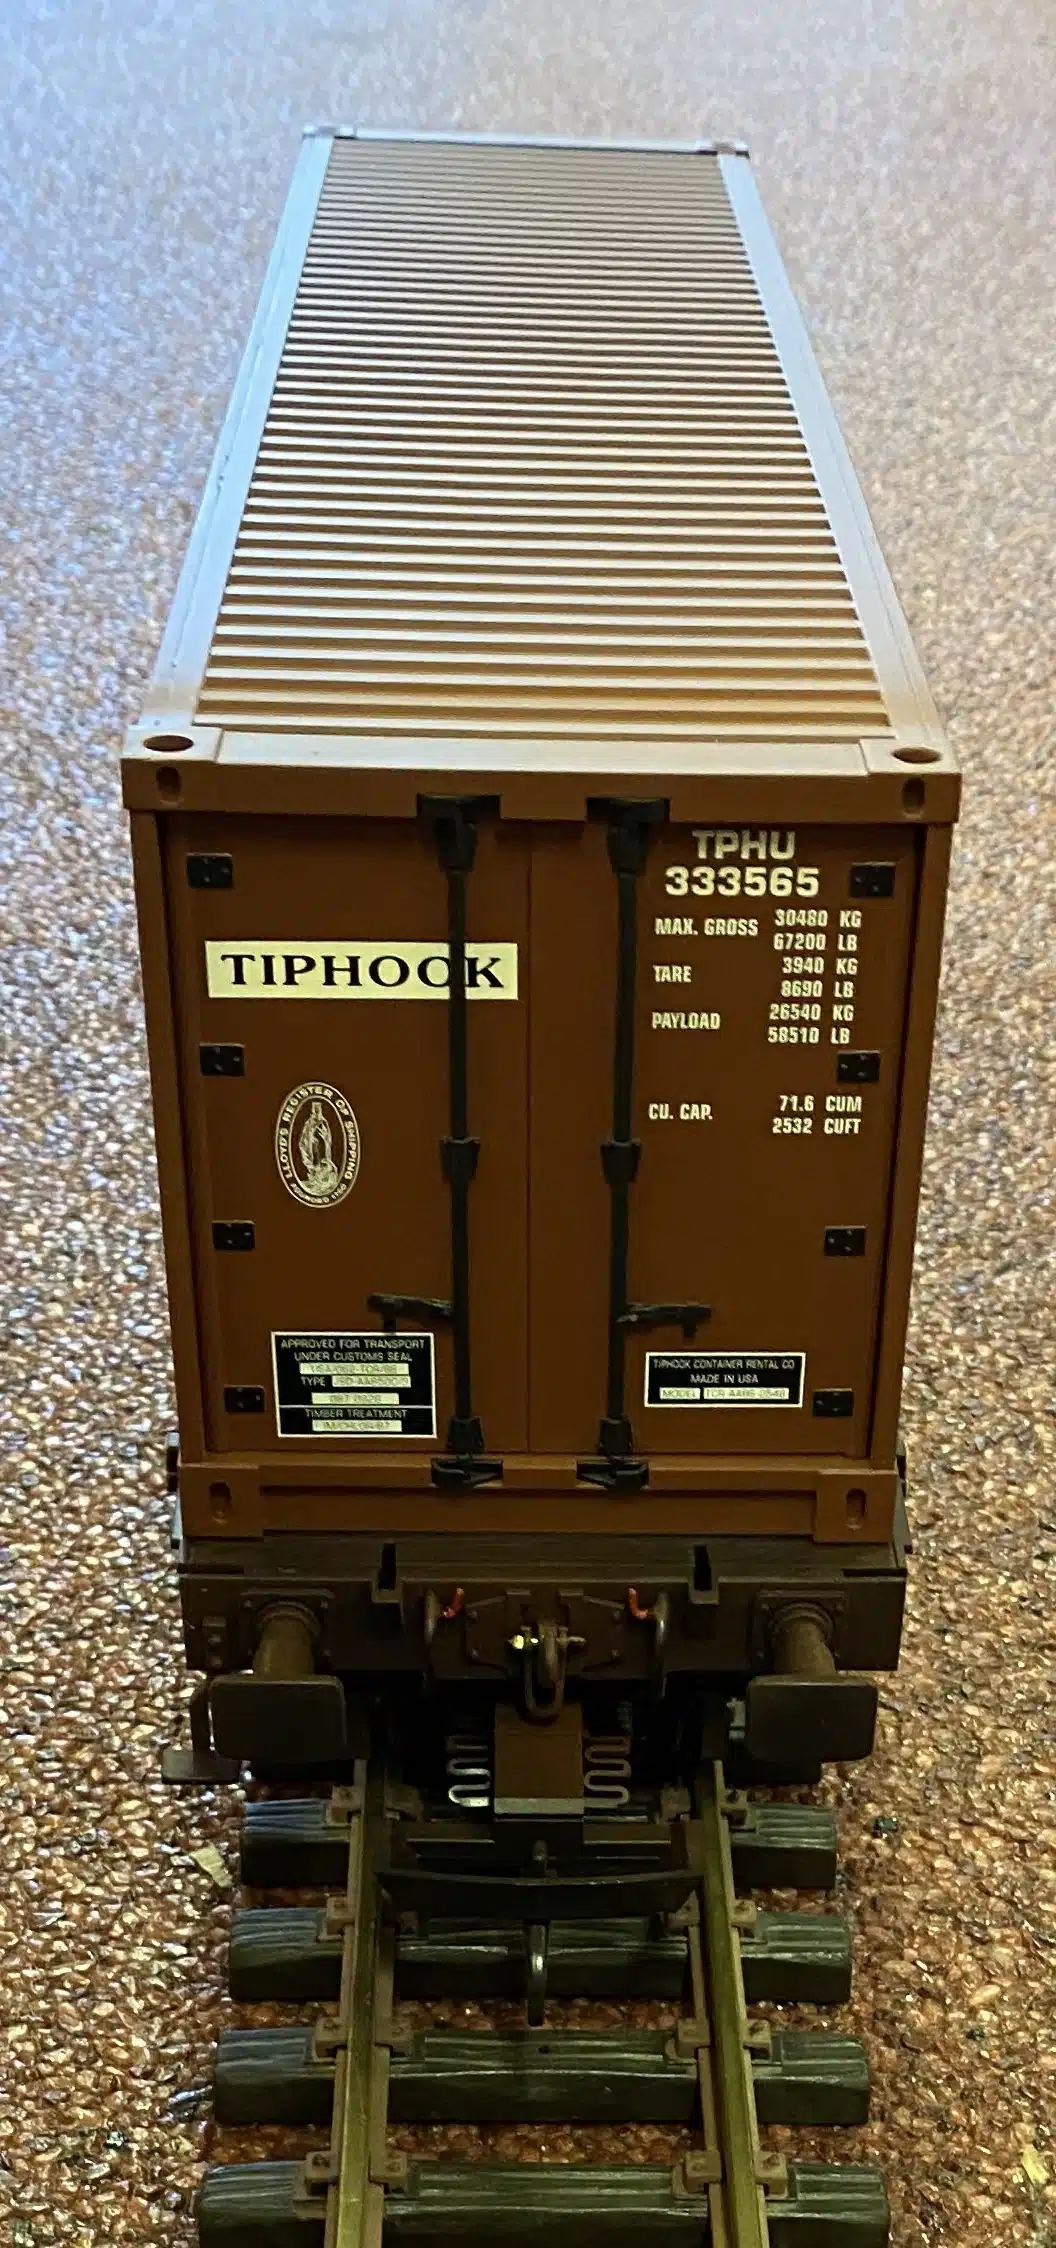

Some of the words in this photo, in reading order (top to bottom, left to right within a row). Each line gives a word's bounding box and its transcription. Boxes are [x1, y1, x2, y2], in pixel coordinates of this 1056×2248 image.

[692, 830, 796, 860] TPHU
[665, 866, 820, 897] 333565
[655, 918, 698, 935] MAX.
[704, 918, 759, 936] GROSS
[774, 909, 828, 928] 30480
[840, 910, 862, 928] KG
[773, 933, 826, 951] 67200
[838, 934, 858, 952] LB
[221, 954, 504, 988] TIPHOOK
[653, 965, 692, 983] TARE
[782, 956, 825, 975] 3940
[836, 957, 858, 975] KG
[781, 980, 823, 998] 8690
[834, 981, 855, 998] LB
[652, 1012, 721, 1030] PAYLOAD
[769, 1003, 821, 1021] 26540
[832, 1004, 855, 1022] KG
[767, 1027, 820, 1044] 58510
[830, 1027, 850, 1044] LB
[648, 1103, 674, 1120] CU.
[679, 1104, 713, 1121] CAP.
[779, 1095, 814, 1112] 71.6
[825, 1096, 862, 1113] CUM
[772, 1118, 812, 1134] 2532
[823, 1118, 862, 1134] CUFT
[335, 1099, 350, 1116] OF
[344, 1121, 357, 1180] SHIPPING
[280, 1339, 336, 1349] APPROVED
[339, 1339, 360, 1349] FOR
[364, 1339, 425, 1349] TRANSPORT
[294, 1351, 331, 1361] UNDER
[333, 1351, 383, 1361] CUSTOMS
[387, 1352, 412, 1362] SEAL
[653, 1359, 691, 1369] TIPHOOK
[693, 1359, 743, 1369] CONTAINER
[746, 1359, 779, 1369] RENTAL
[781, 1359, 795, 1369] CO
[301, 1376, 326, 1386] TYPE
[690, 1374, 720, 1383] MADE
[724, 1374, 735, 1383] IN
[738, 1374, 759, 1384] USA
[305, 1408, 343, 1418] TIMBER
[346, 1408, 408, 1419] TREATMENT
